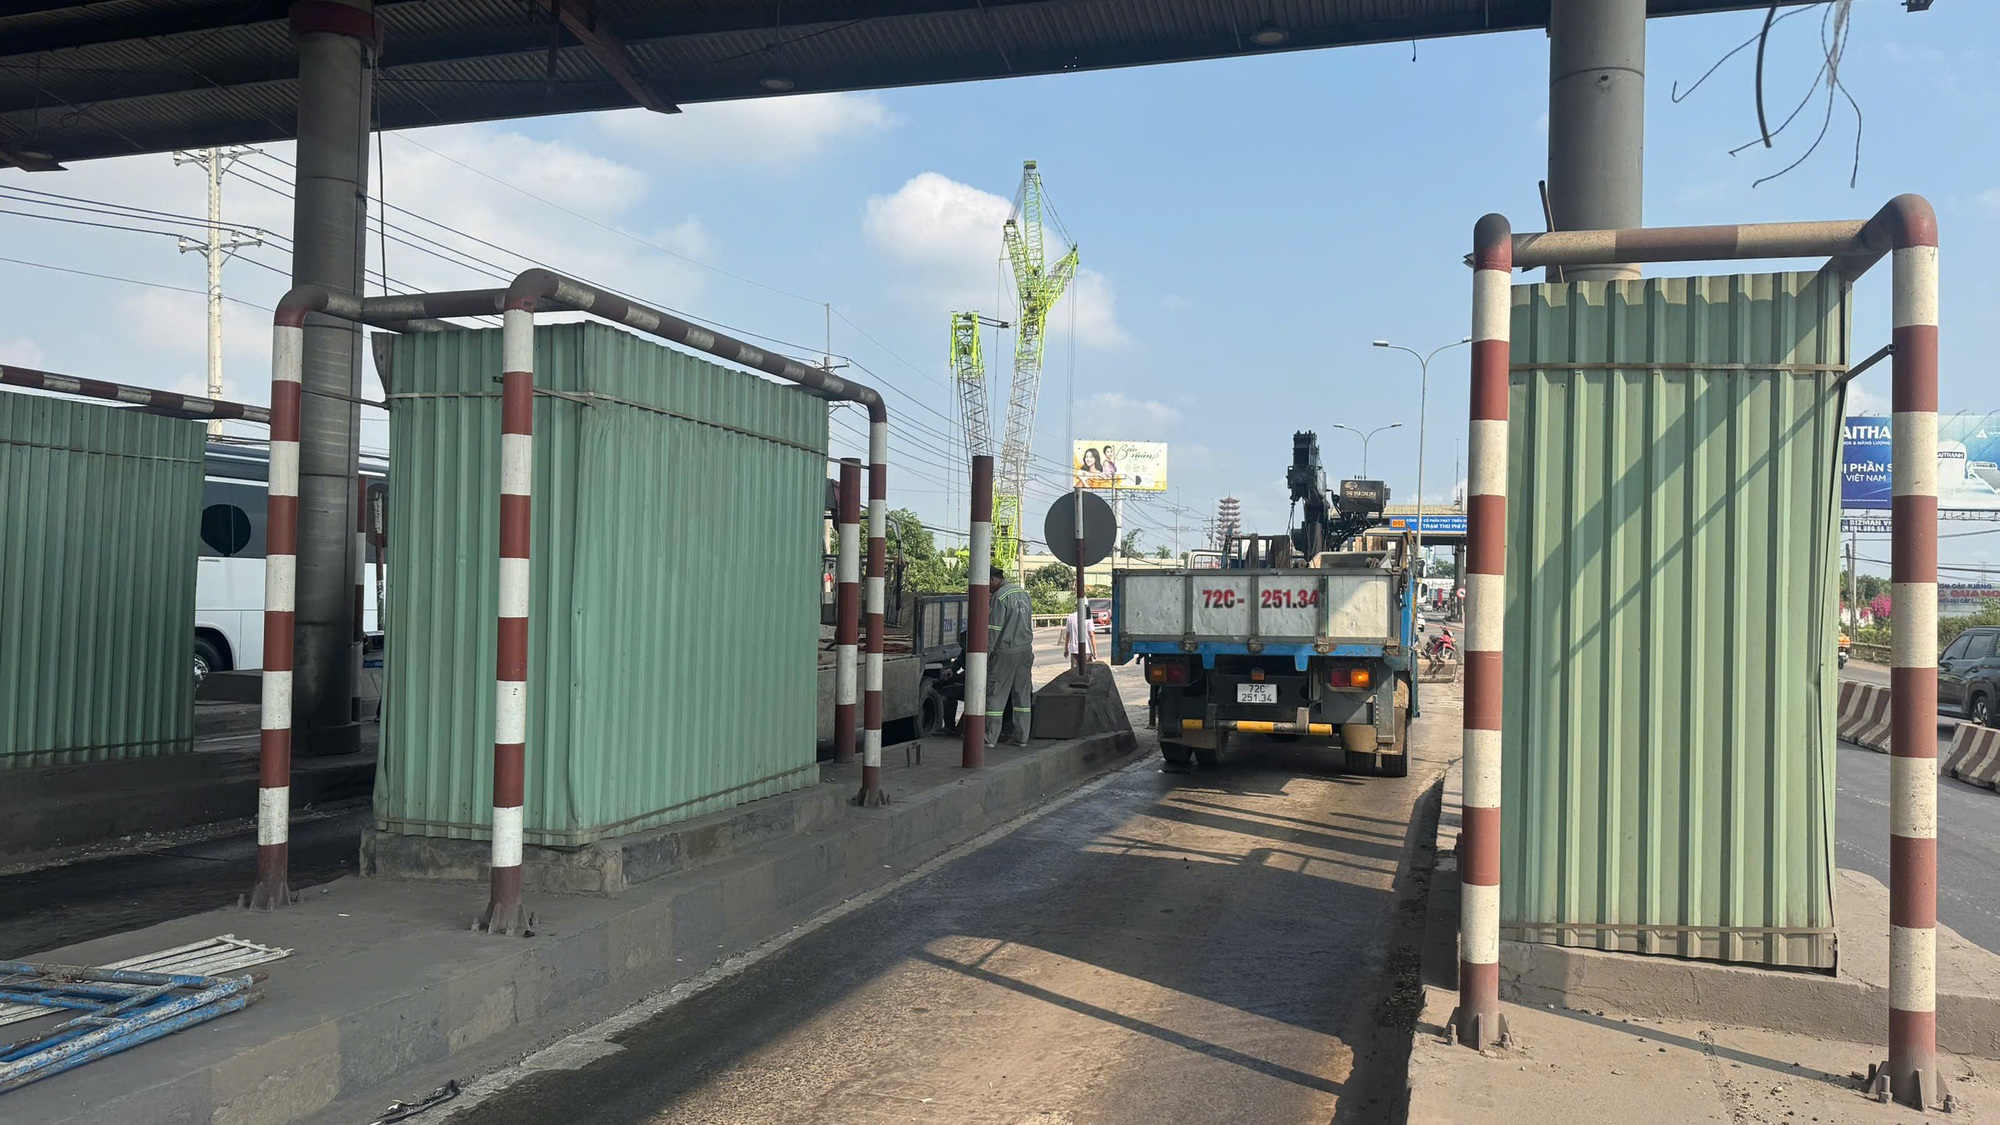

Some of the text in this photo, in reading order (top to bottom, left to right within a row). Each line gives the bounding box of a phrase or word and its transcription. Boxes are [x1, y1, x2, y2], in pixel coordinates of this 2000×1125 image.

[1850, 460, 1884, 472] PHẦN
[1846, 473, 1886, 482] VIỆT NAM
[1261, 589, 1320, 609] 251.34
[1248, 685, 1265, 693] 72C
[1241, 694, 1272, 702] 251.34
